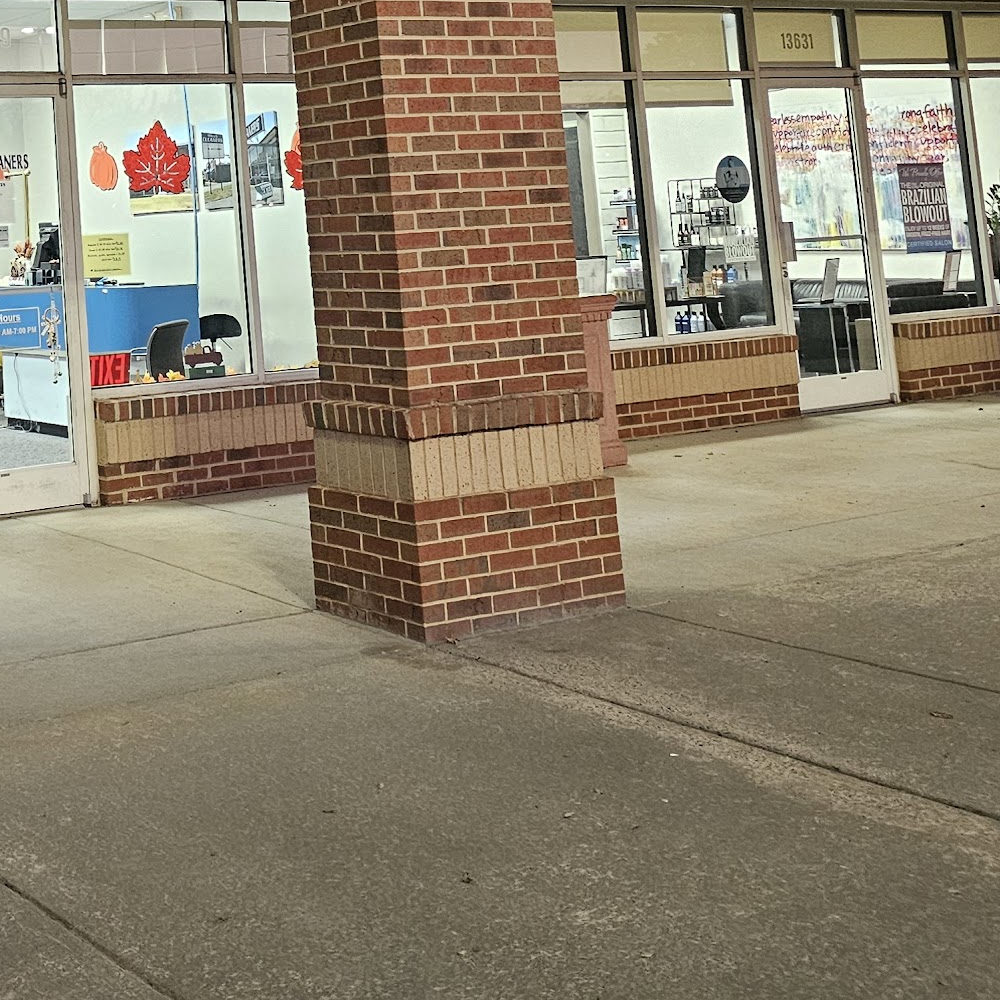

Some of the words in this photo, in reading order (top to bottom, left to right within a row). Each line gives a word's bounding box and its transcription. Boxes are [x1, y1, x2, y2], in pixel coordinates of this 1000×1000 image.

[780, 32, 814, 50] 13631
[900, 187, 948, 206] BRAZILIAN
[903, 204, 948, 223] BLOWOUT
[725, 244, 755, 258] BLOWOUT
[907, 240, 934, 248] CERTIFIED
[27, 326, 37, 334] PM
